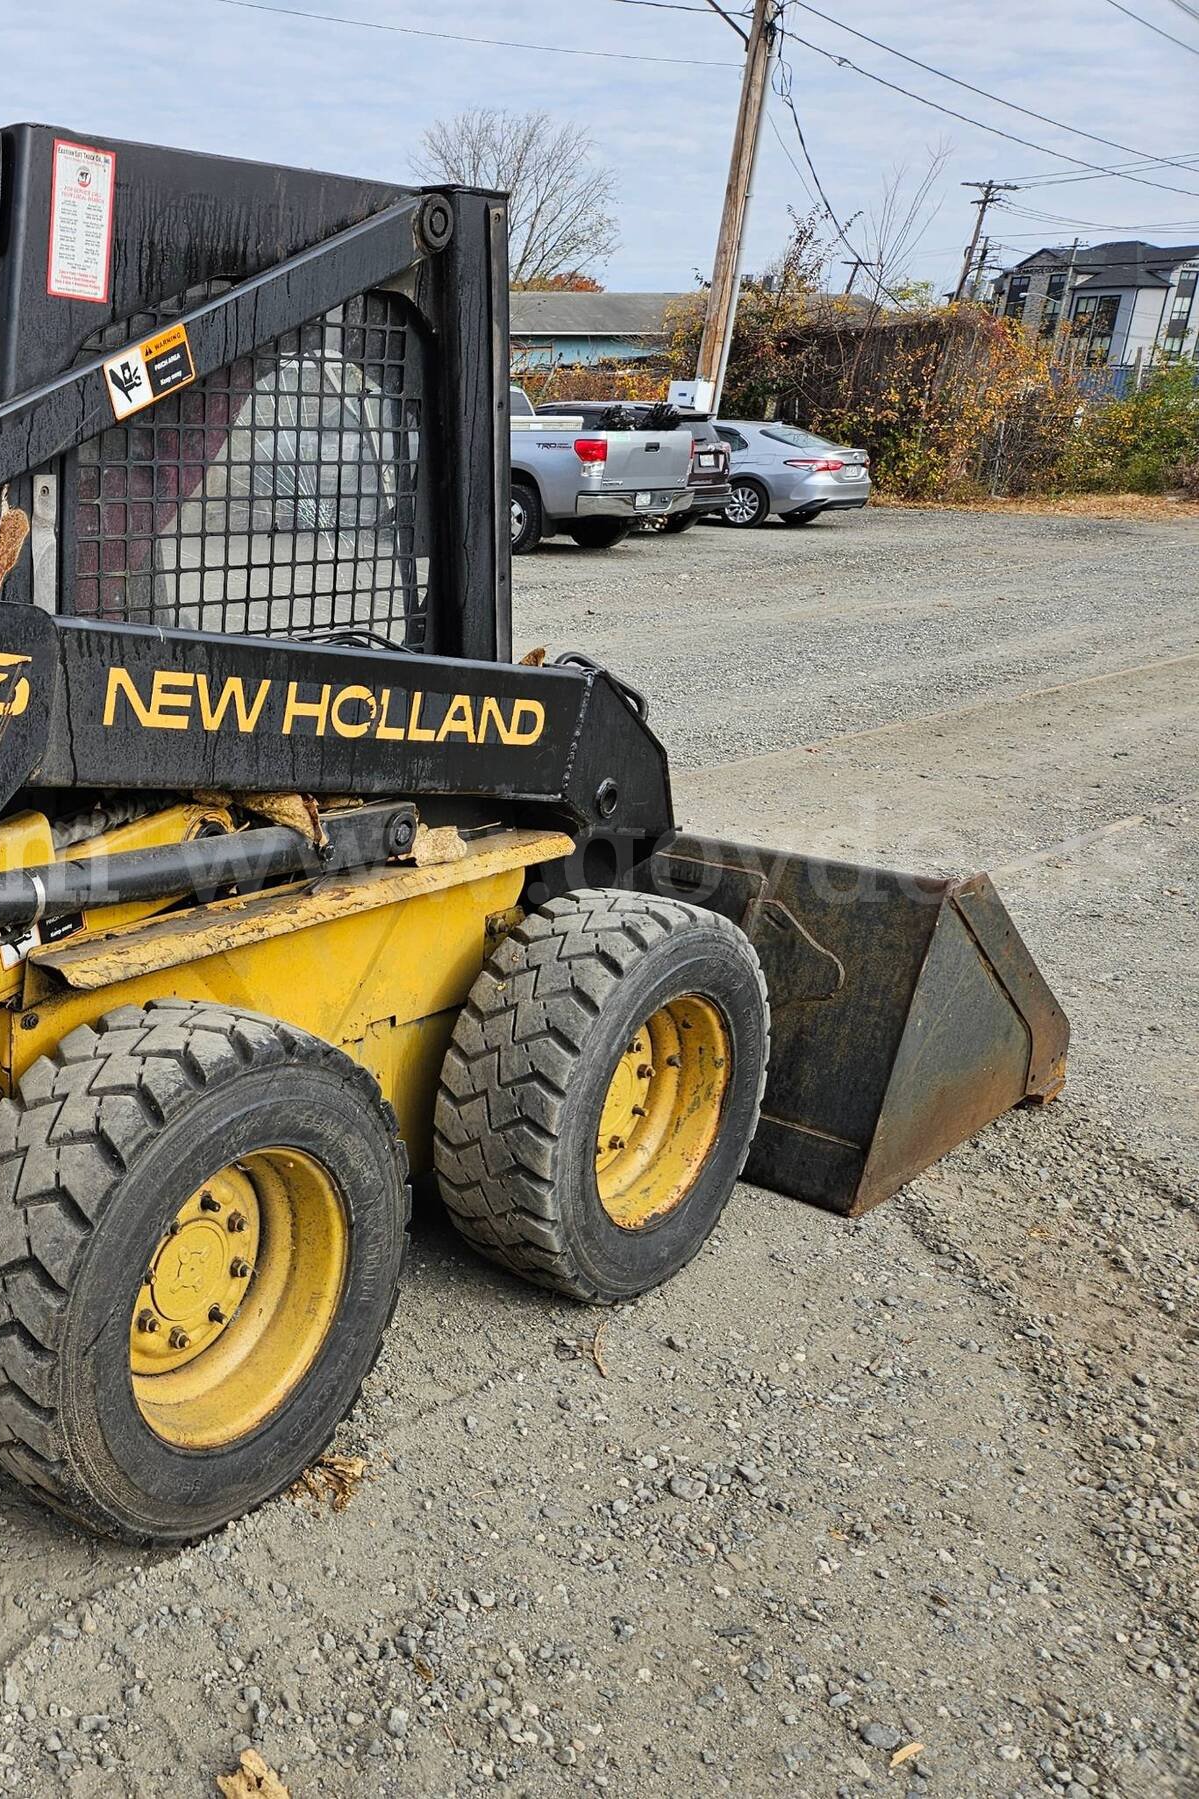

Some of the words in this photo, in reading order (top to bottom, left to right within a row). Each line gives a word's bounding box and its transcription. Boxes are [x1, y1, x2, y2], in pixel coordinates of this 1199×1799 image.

[154, 332, 181, 350] WARNING
[103, 667, 271, 733] NEW
[282, 681, 546, 746] HOLLAND
